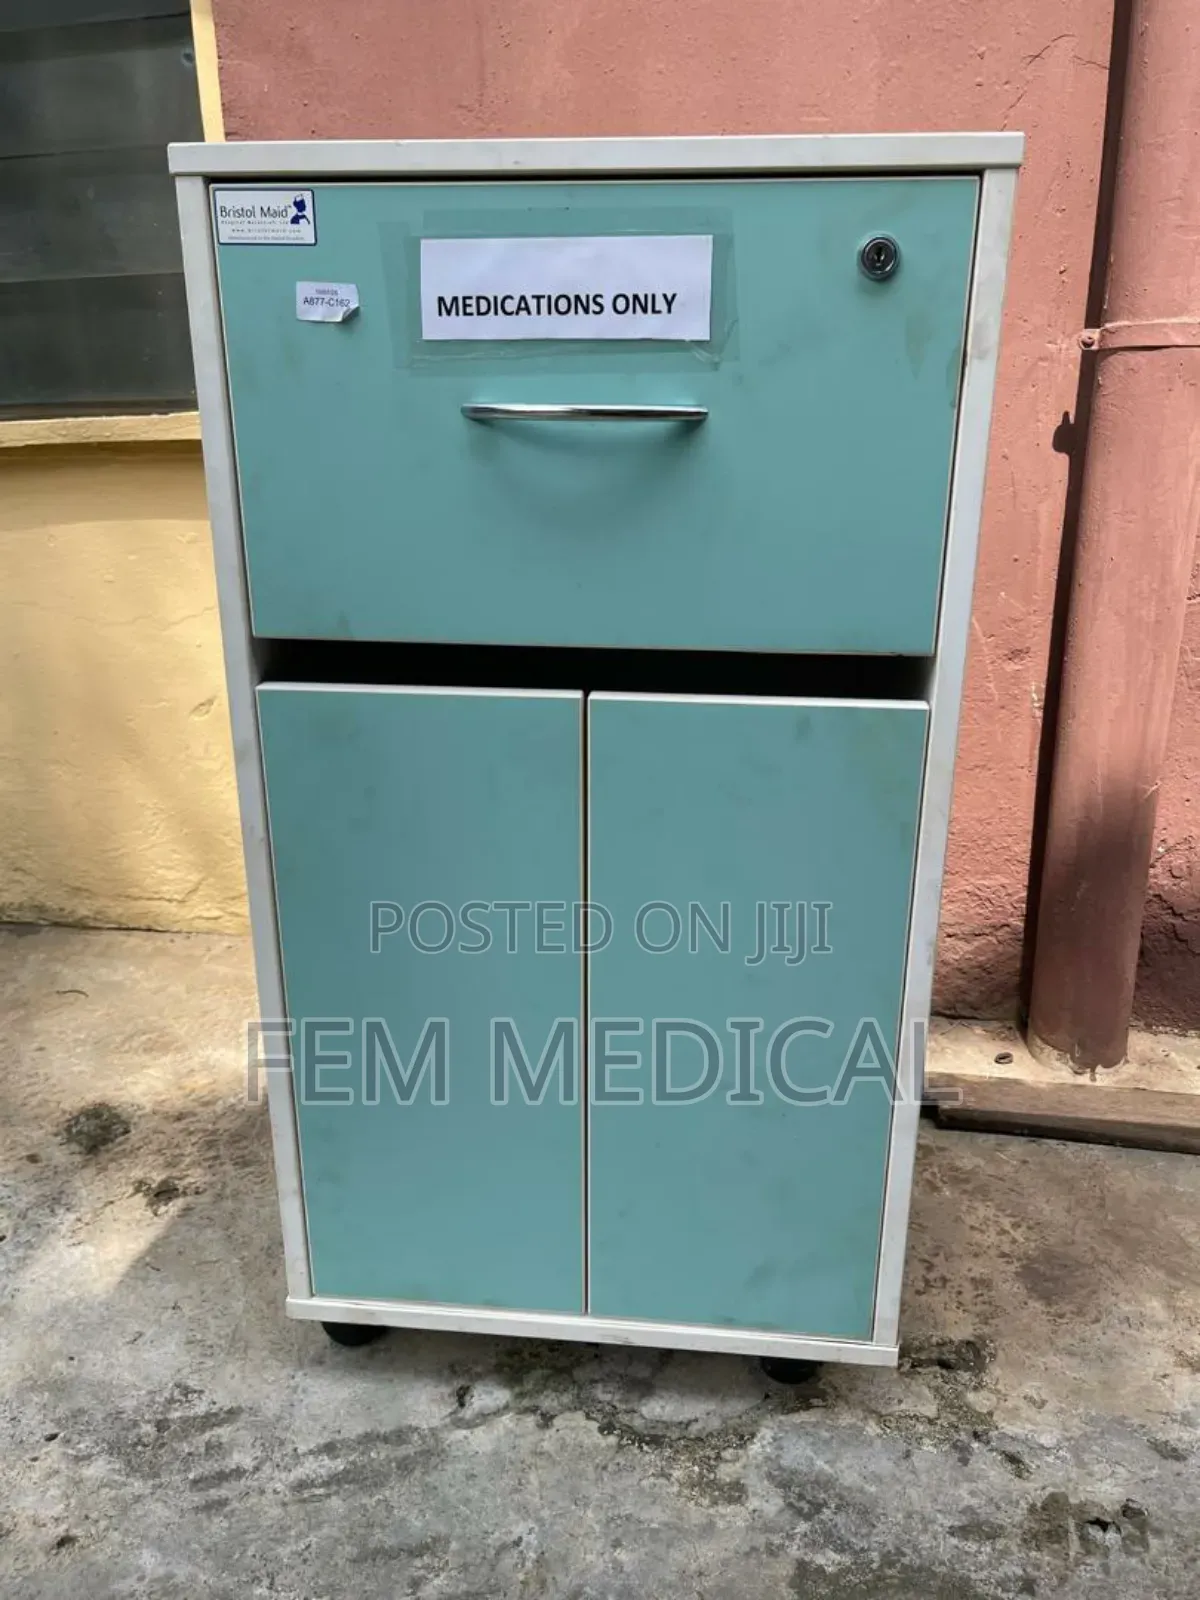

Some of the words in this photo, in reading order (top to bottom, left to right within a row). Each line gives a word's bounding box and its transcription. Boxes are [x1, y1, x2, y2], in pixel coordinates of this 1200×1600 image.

[220, 205, 256, 218] Bristol
[260, 205, 288, 218] Maid
[437, 293, 605, 317] MEDICATIONS
[612, 292, 678, 315] ONLY
